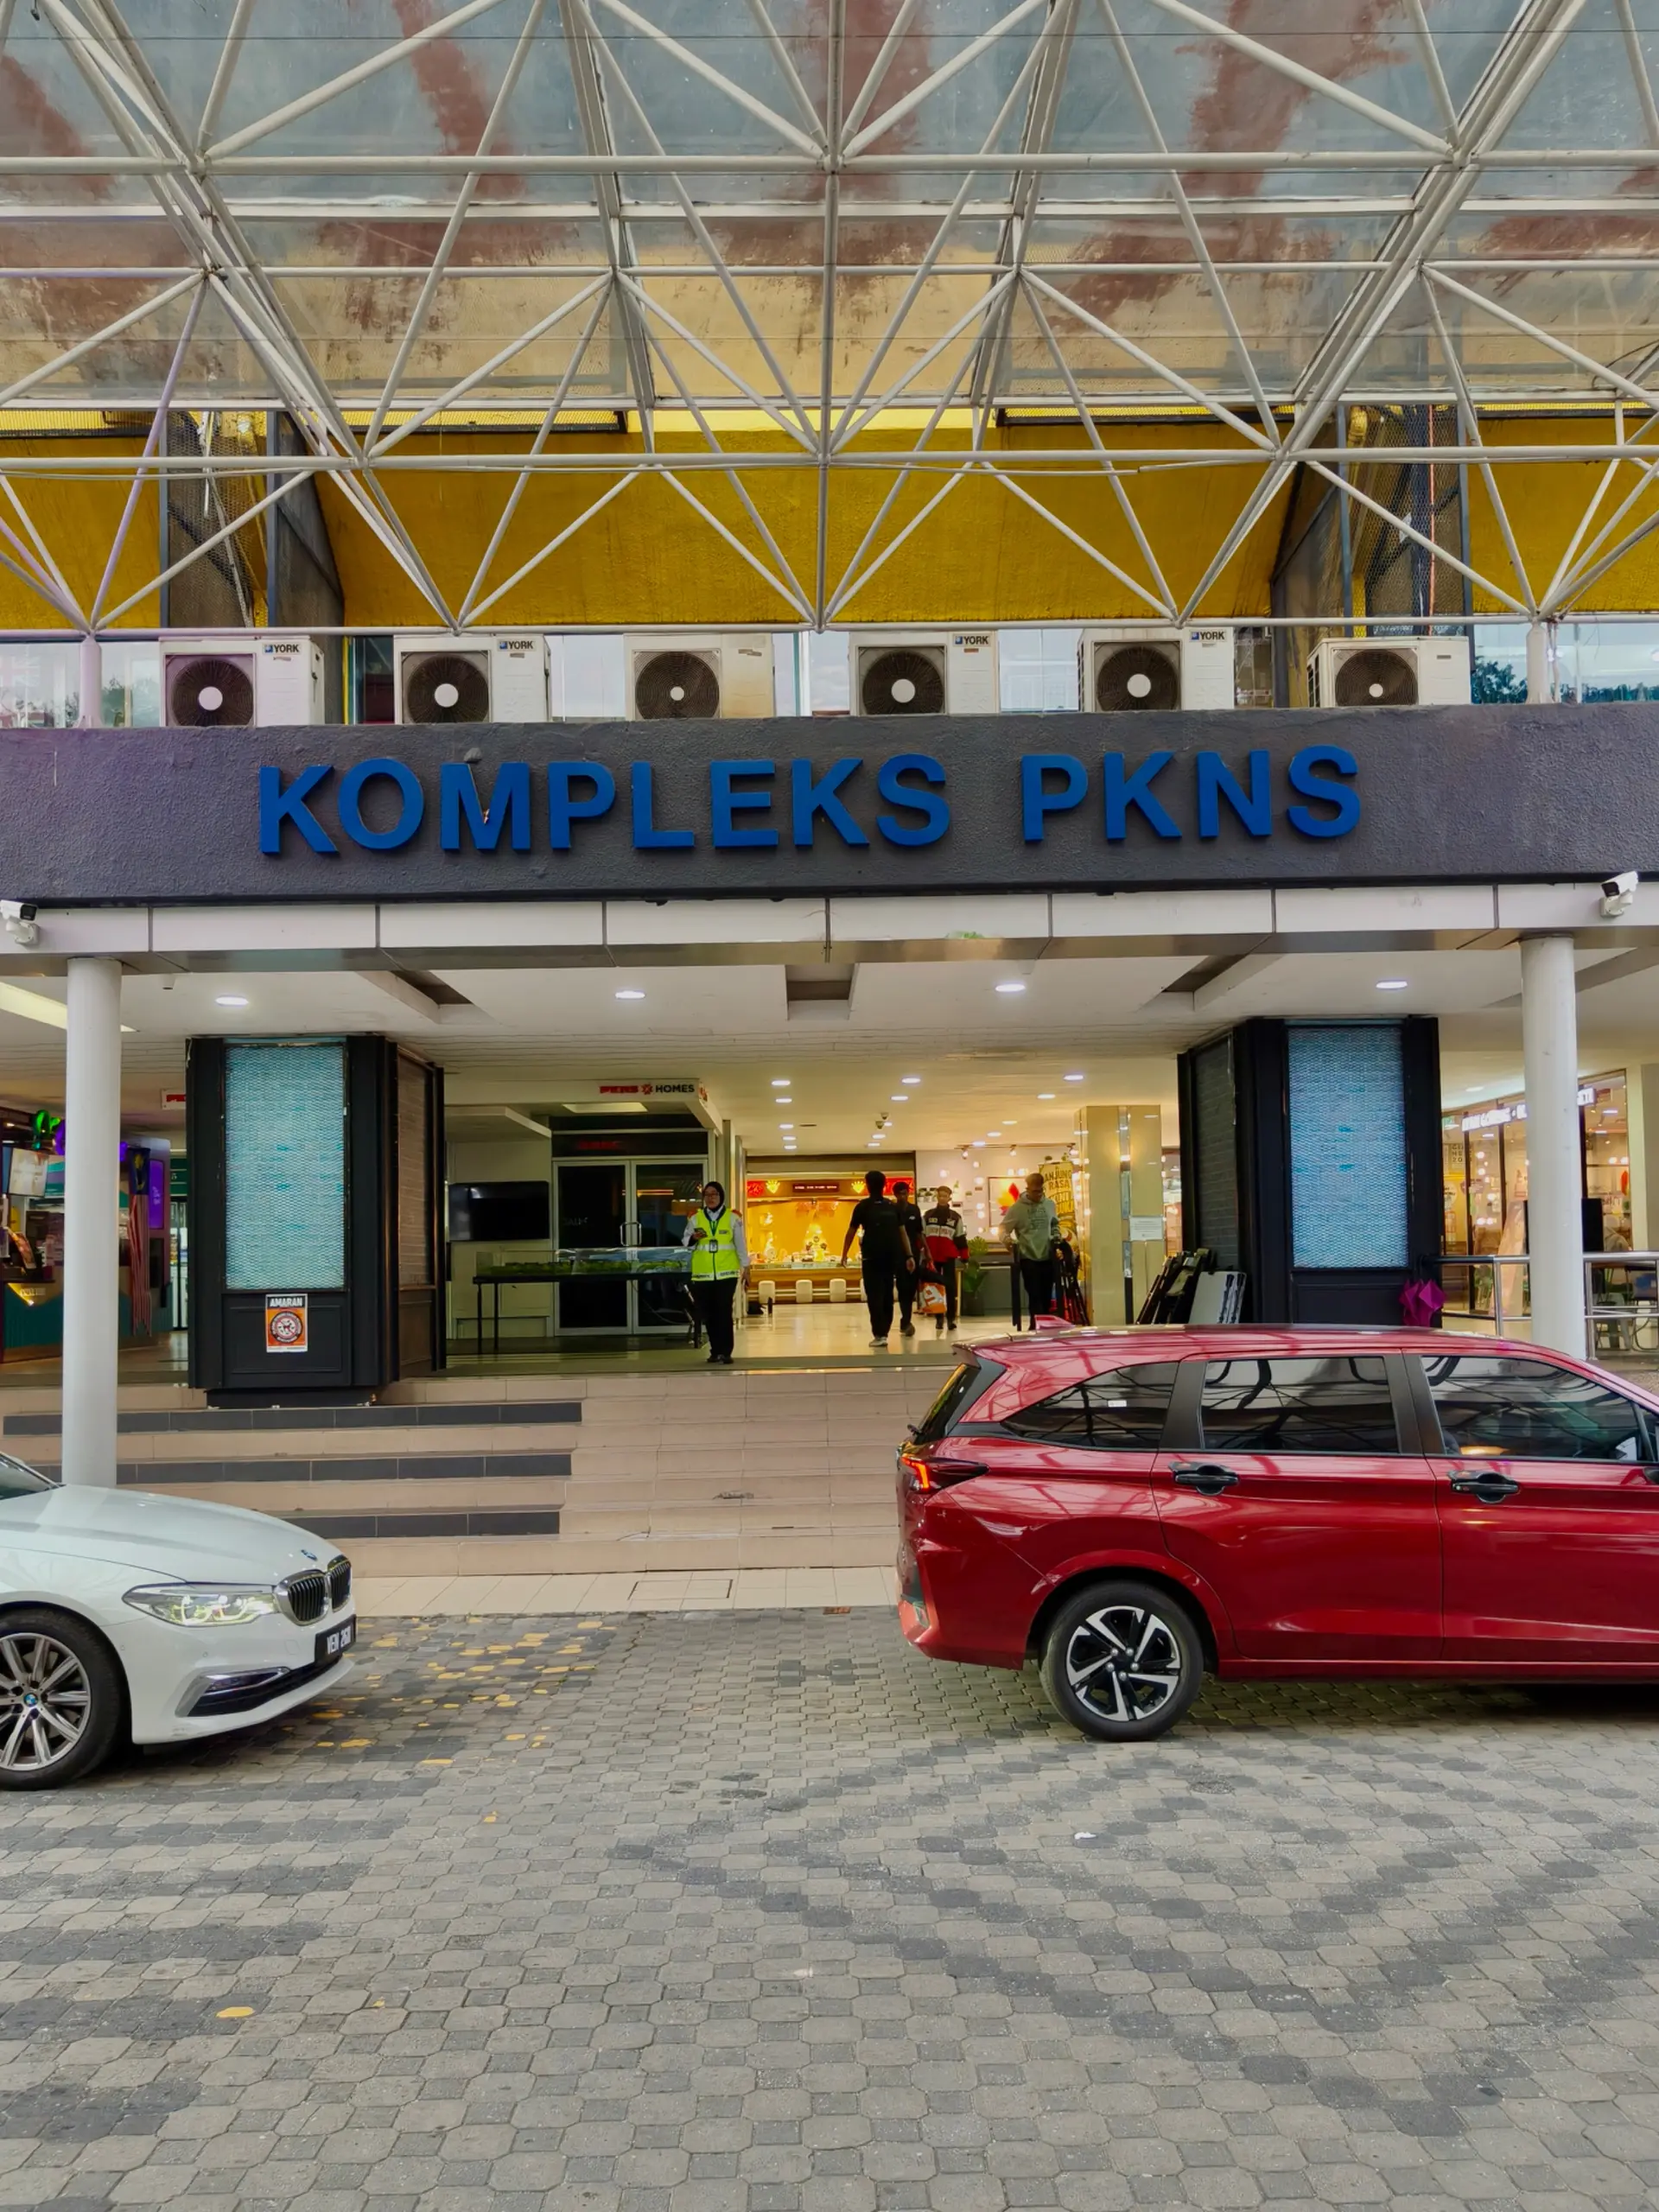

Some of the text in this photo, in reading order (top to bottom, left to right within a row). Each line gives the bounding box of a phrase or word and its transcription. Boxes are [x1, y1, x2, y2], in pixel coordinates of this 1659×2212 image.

[963, 635, 989, 645] YORK
[1200, 631, 1225, 640] YORK
[274, 644, 300, 653] YORK
[509, 640, 534, 650] YORK
[257, 744, 1362, 855] KOMPLEKS PKNS
[655, 1084, 696, 1093] HOMES
[1049, 1179, 1071, 1191] RASA
[270, 1297, 303, 1307] AMARAN
